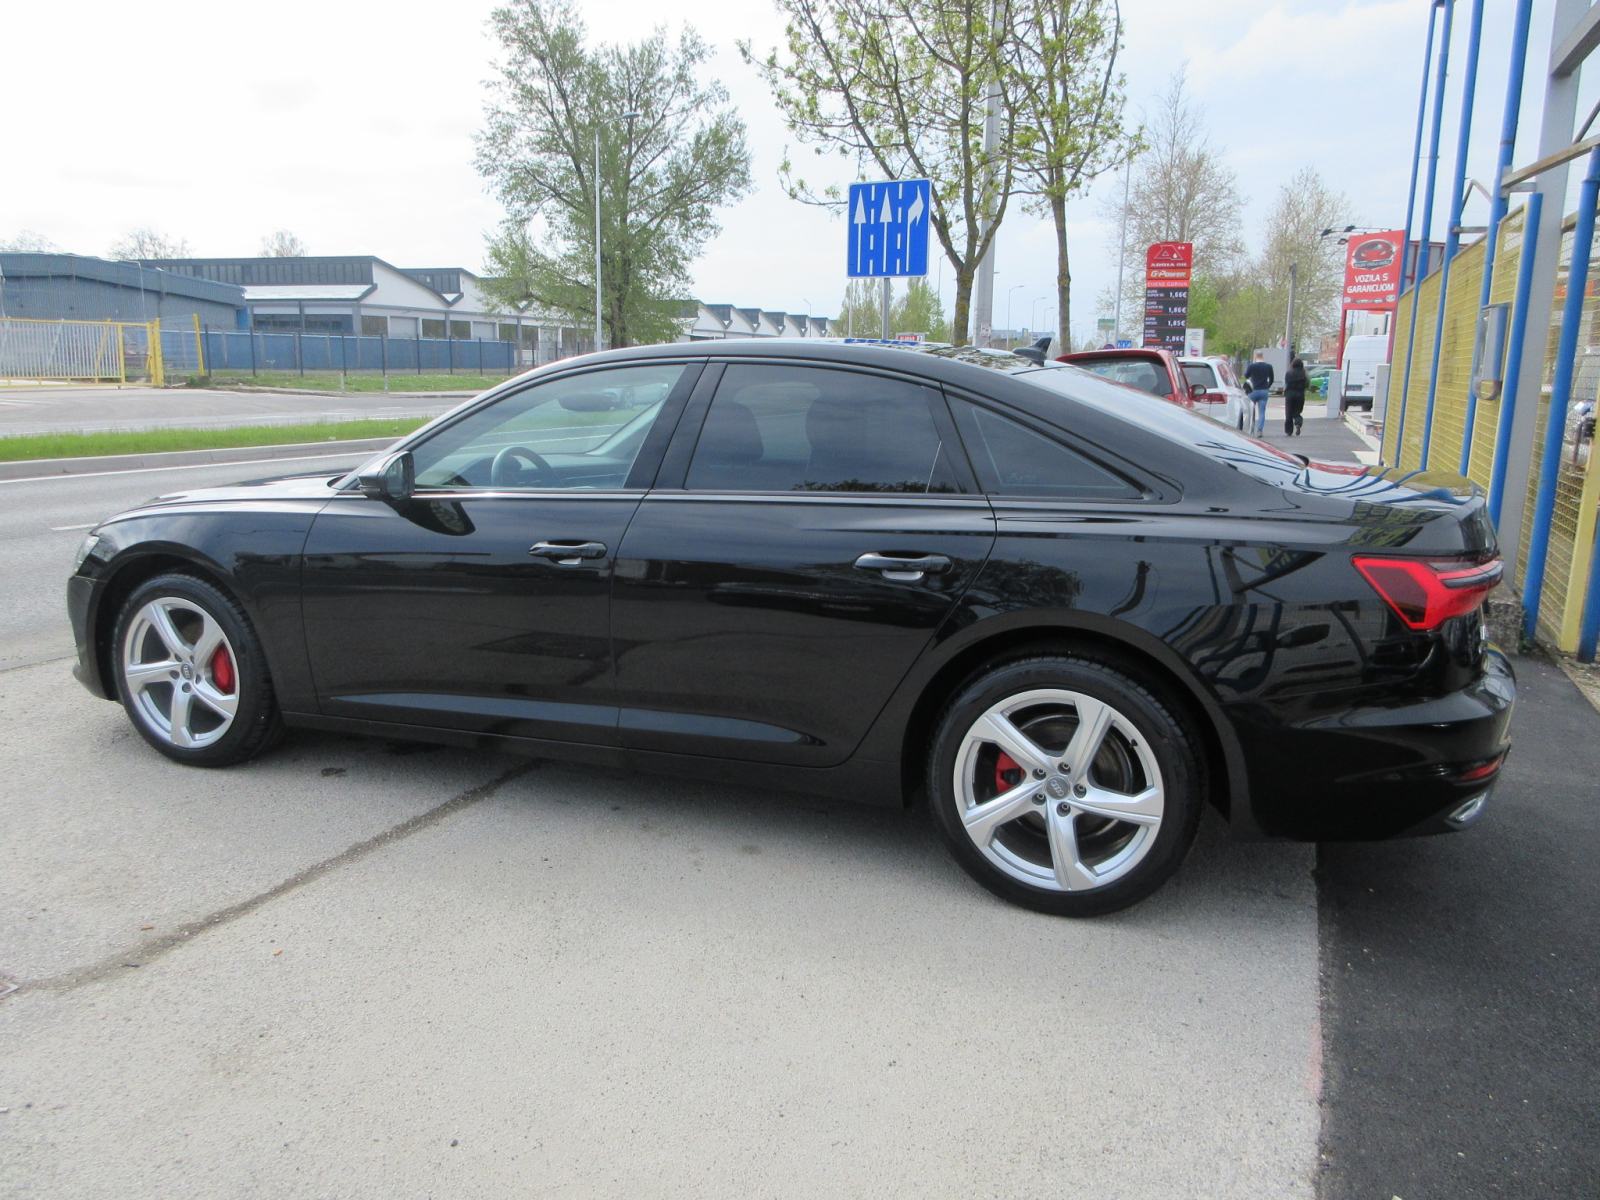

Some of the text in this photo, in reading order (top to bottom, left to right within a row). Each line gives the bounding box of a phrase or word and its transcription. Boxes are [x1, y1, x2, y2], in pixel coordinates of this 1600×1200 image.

[1354, 272, 1389, 283] VOZILA S
[1346, 283, 1394, 294] GARANCIJOM
